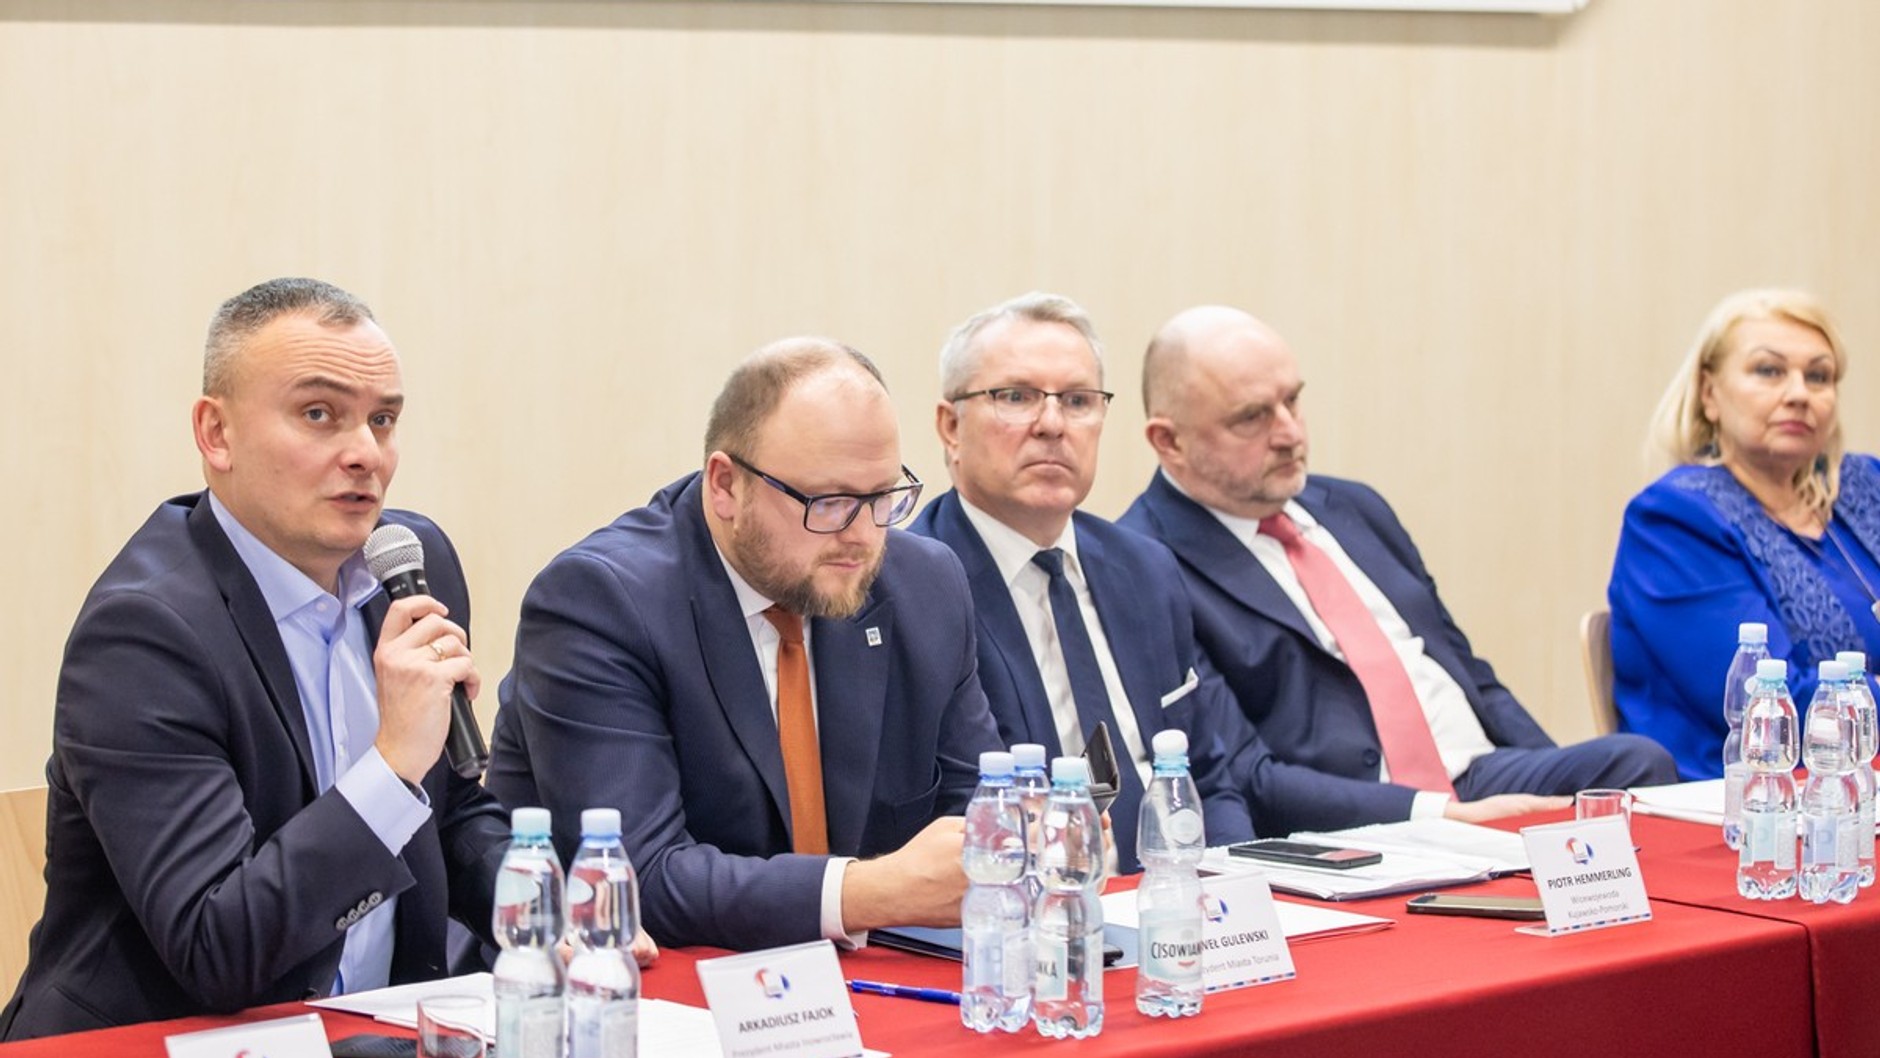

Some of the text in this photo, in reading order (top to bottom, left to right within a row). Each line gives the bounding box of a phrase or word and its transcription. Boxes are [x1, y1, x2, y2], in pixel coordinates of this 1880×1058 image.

[1547, 867, 1632, 890] PIOTR HEMMERLING
[1220, 929, 1269, 947] GULEWSKI
[739, 1007, 835, 1032] ARKADIUSZ FAJOK
